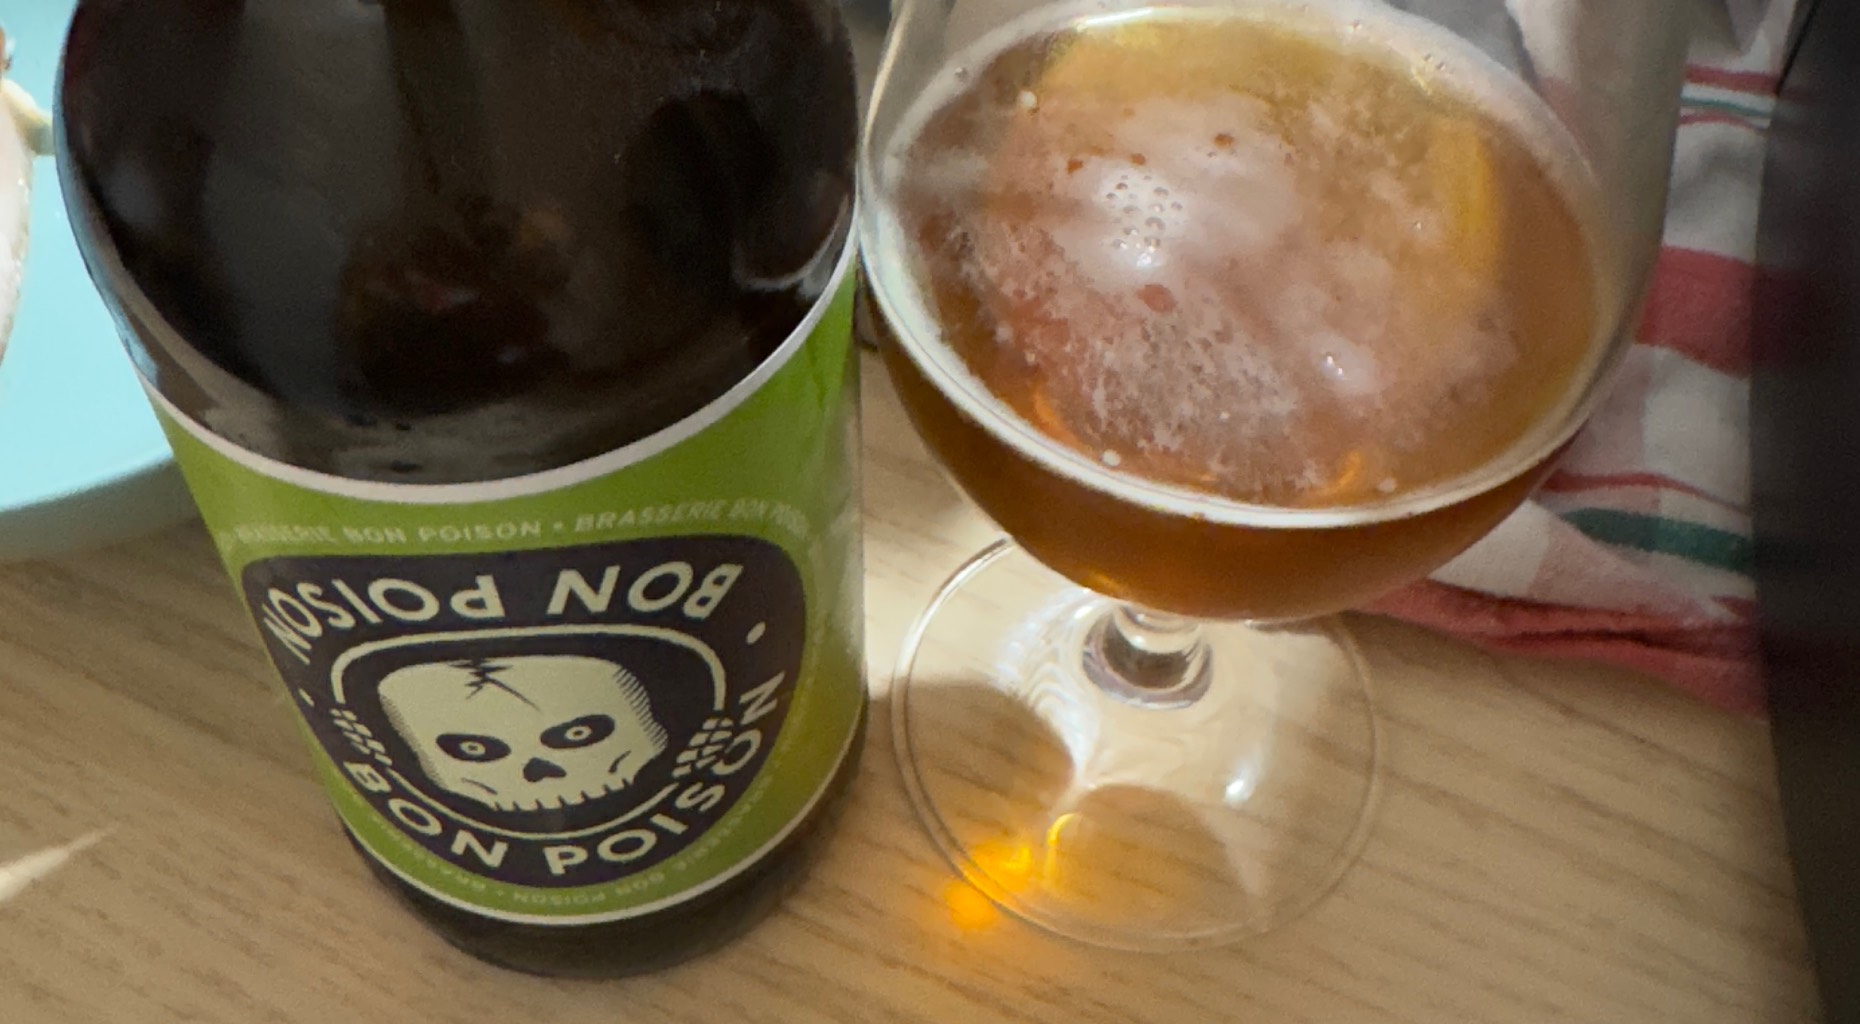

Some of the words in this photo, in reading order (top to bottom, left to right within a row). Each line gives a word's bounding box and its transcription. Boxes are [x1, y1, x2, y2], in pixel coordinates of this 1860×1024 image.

[343, 527, 407, 544] BON
[418, 521, 541, 543] POISON
[574, 498, 728, 533] BRASSERIE
[262, 574, 506, 666] POISON
[546, 560, 745, 620] BON
[343, 761, 509, 869] BON
[543, 670, 786, 876] POISON
